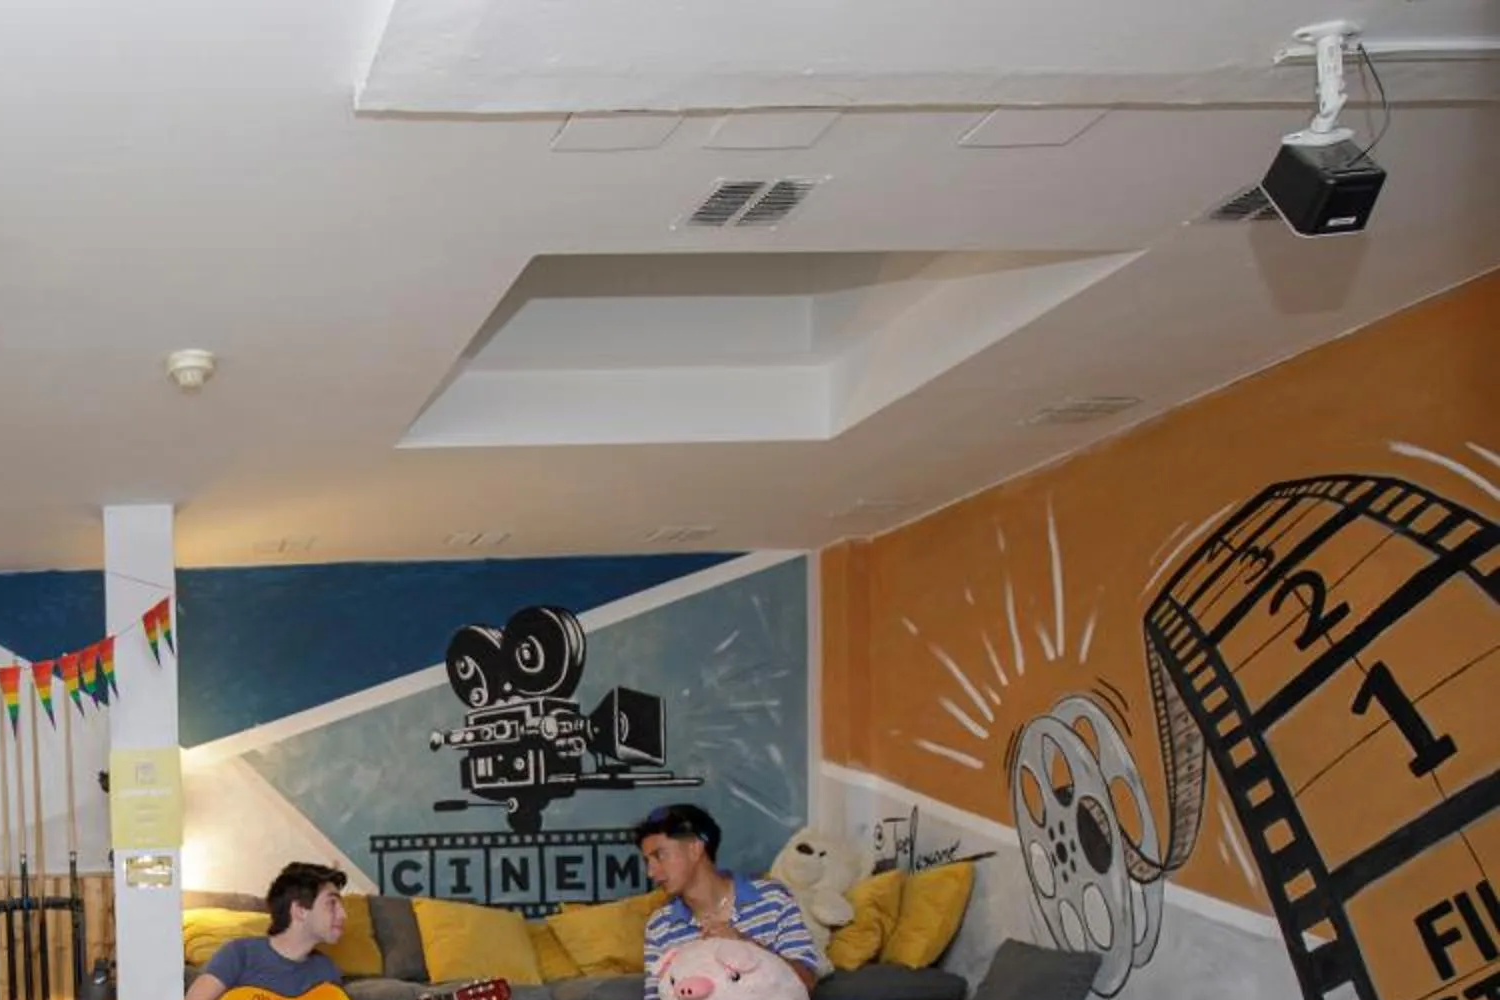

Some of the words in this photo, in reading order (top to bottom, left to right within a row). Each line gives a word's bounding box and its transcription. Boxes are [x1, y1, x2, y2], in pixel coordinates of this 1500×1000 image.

[1269, 570, 1350, 652] 2
[1351, 660, 1457, 778] 1
[391, 853, 640, 896] CINEM
